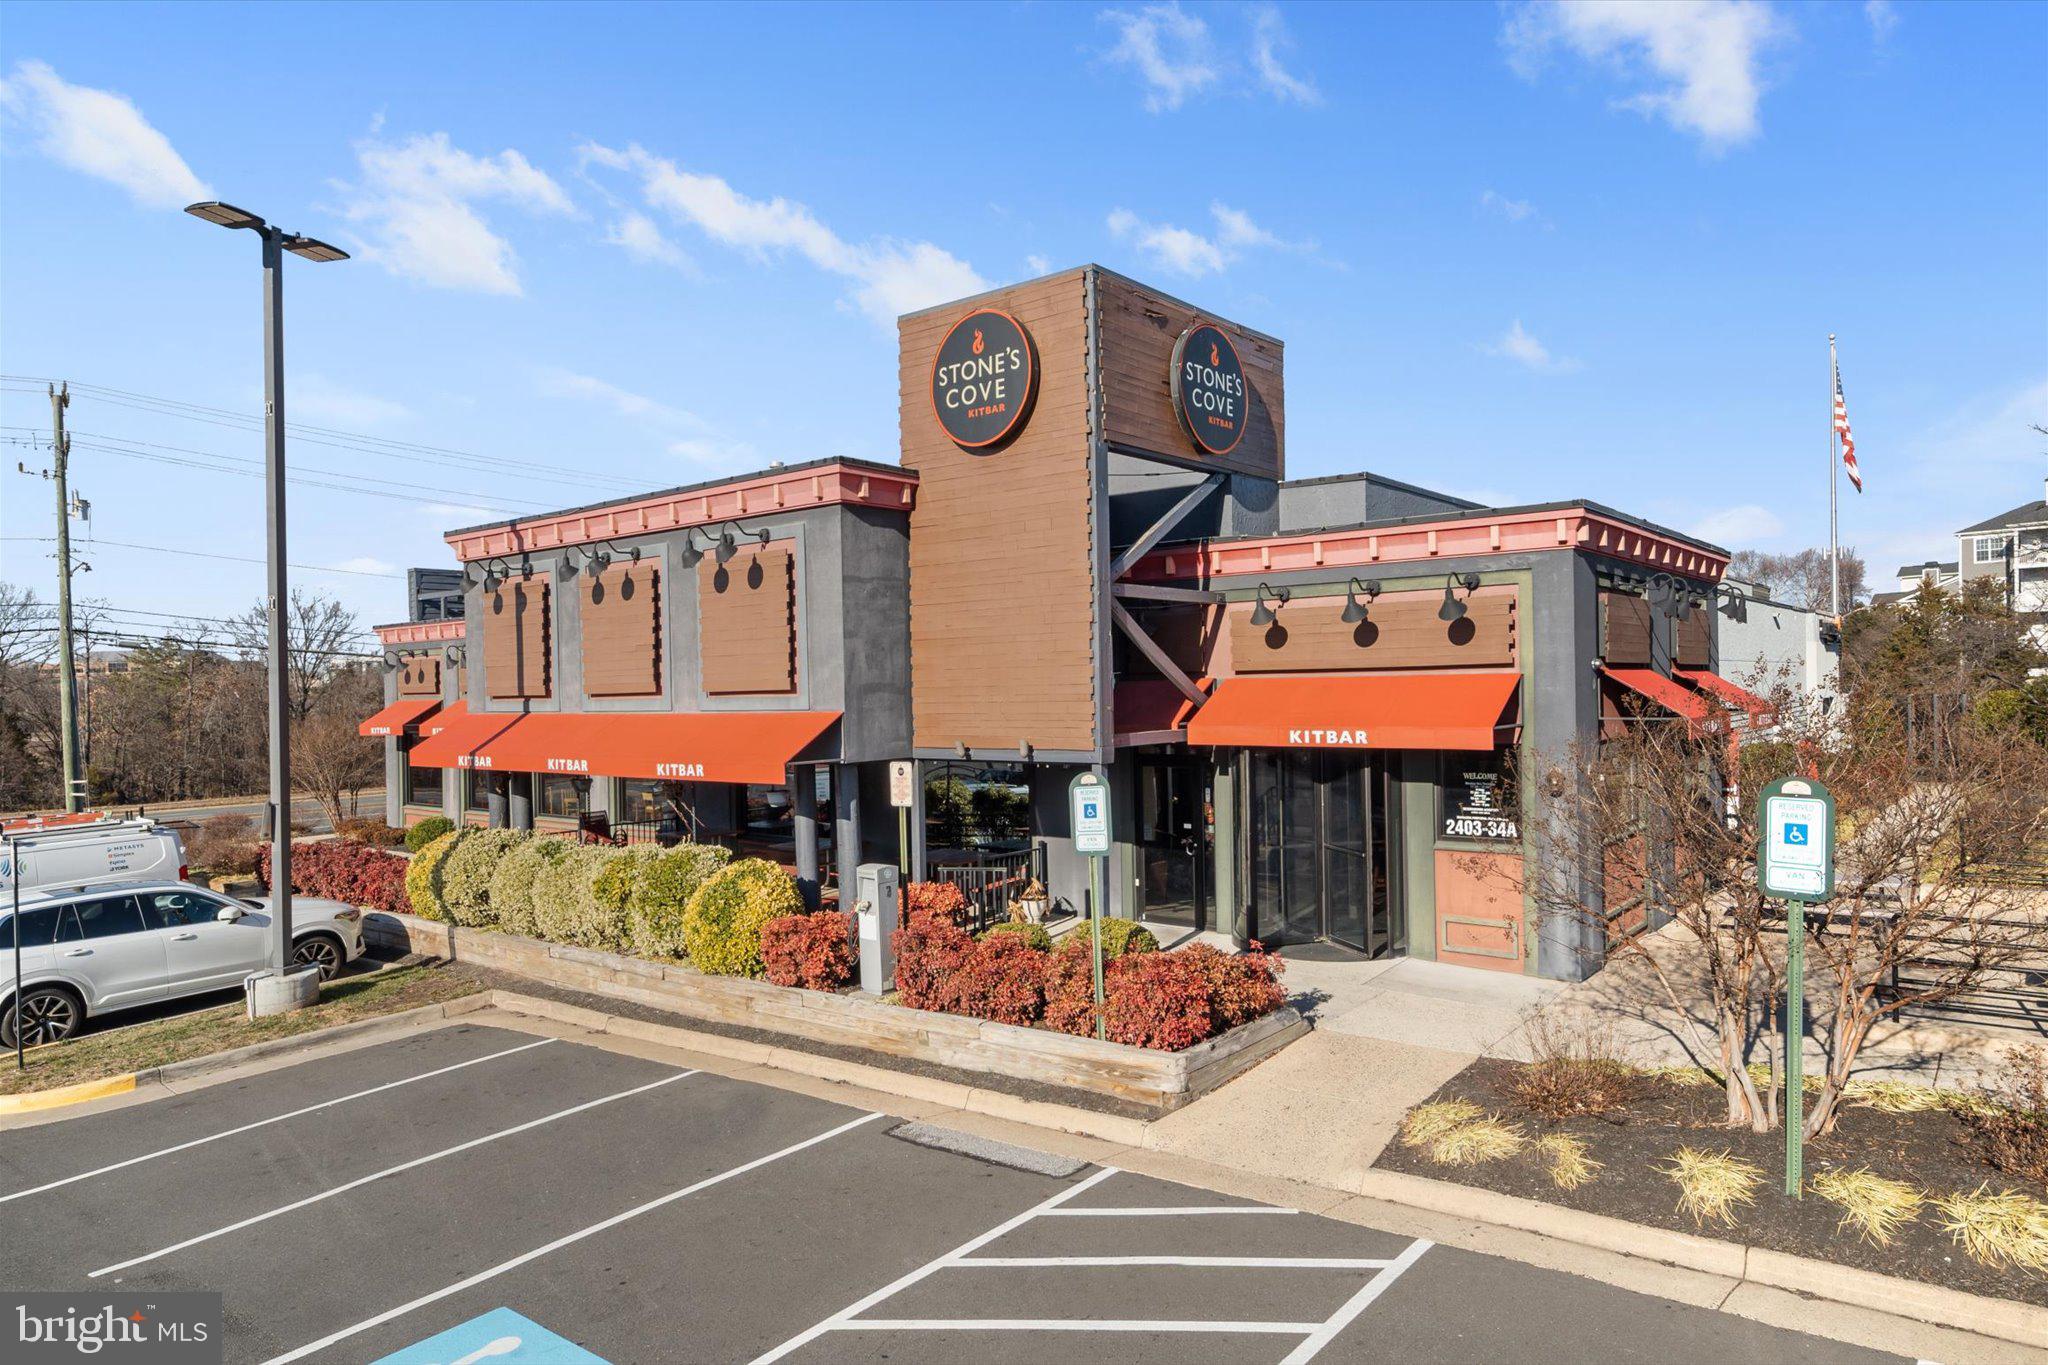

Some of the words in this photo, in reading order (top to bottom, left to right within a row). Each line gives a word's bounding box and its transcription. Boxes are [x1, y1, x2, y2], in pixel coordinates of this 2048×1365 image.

[946, 378, 1006, 409] COVE
[1192, 388, 1234, 417] COVE
[968, 403, 1006, 418] KITBAR
[1208, 415, 1234, 430] KITBAR
[1289, 730, 1368, 744] KITBAR
[458, 755, 492, 767] KITBAR
[547, 758, 588, 771] KITBAR
[656, 763, 704, 777] KITBAR
[1463, 772, 1498, 780] WELCOME
[1446, 818, 1518, 838] 2403-34A
